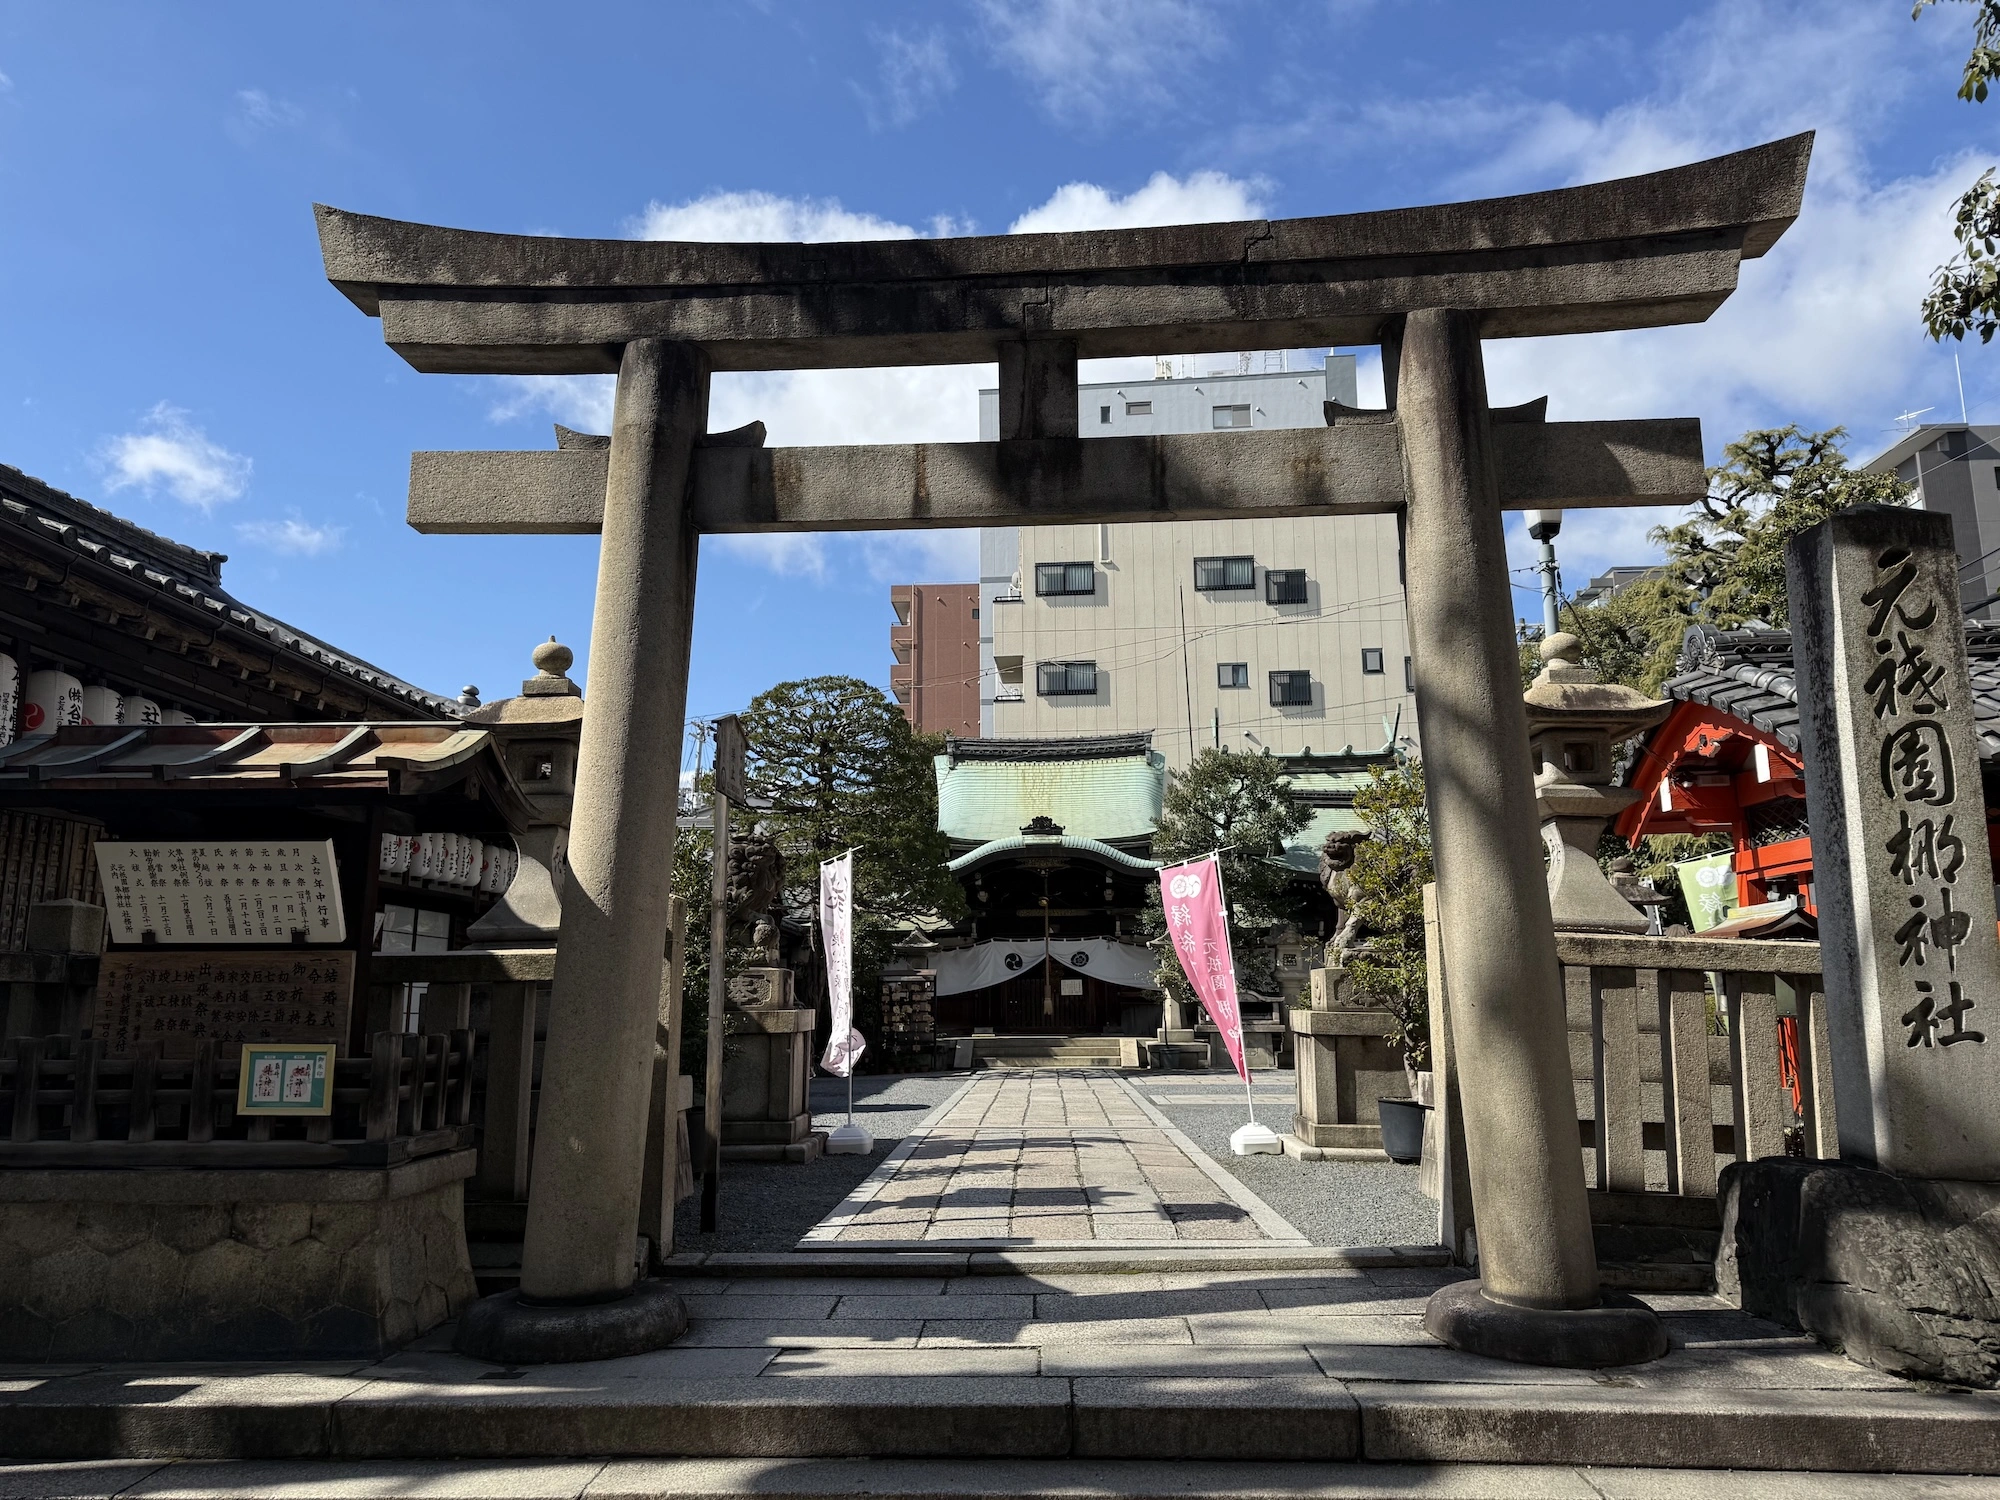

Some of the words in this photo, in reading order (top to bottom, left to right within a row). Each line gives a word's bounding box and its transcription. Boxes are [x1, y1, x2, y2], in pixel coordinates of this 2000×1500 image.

[1860, 549, 1986, 1048] 元祇園梛神社
